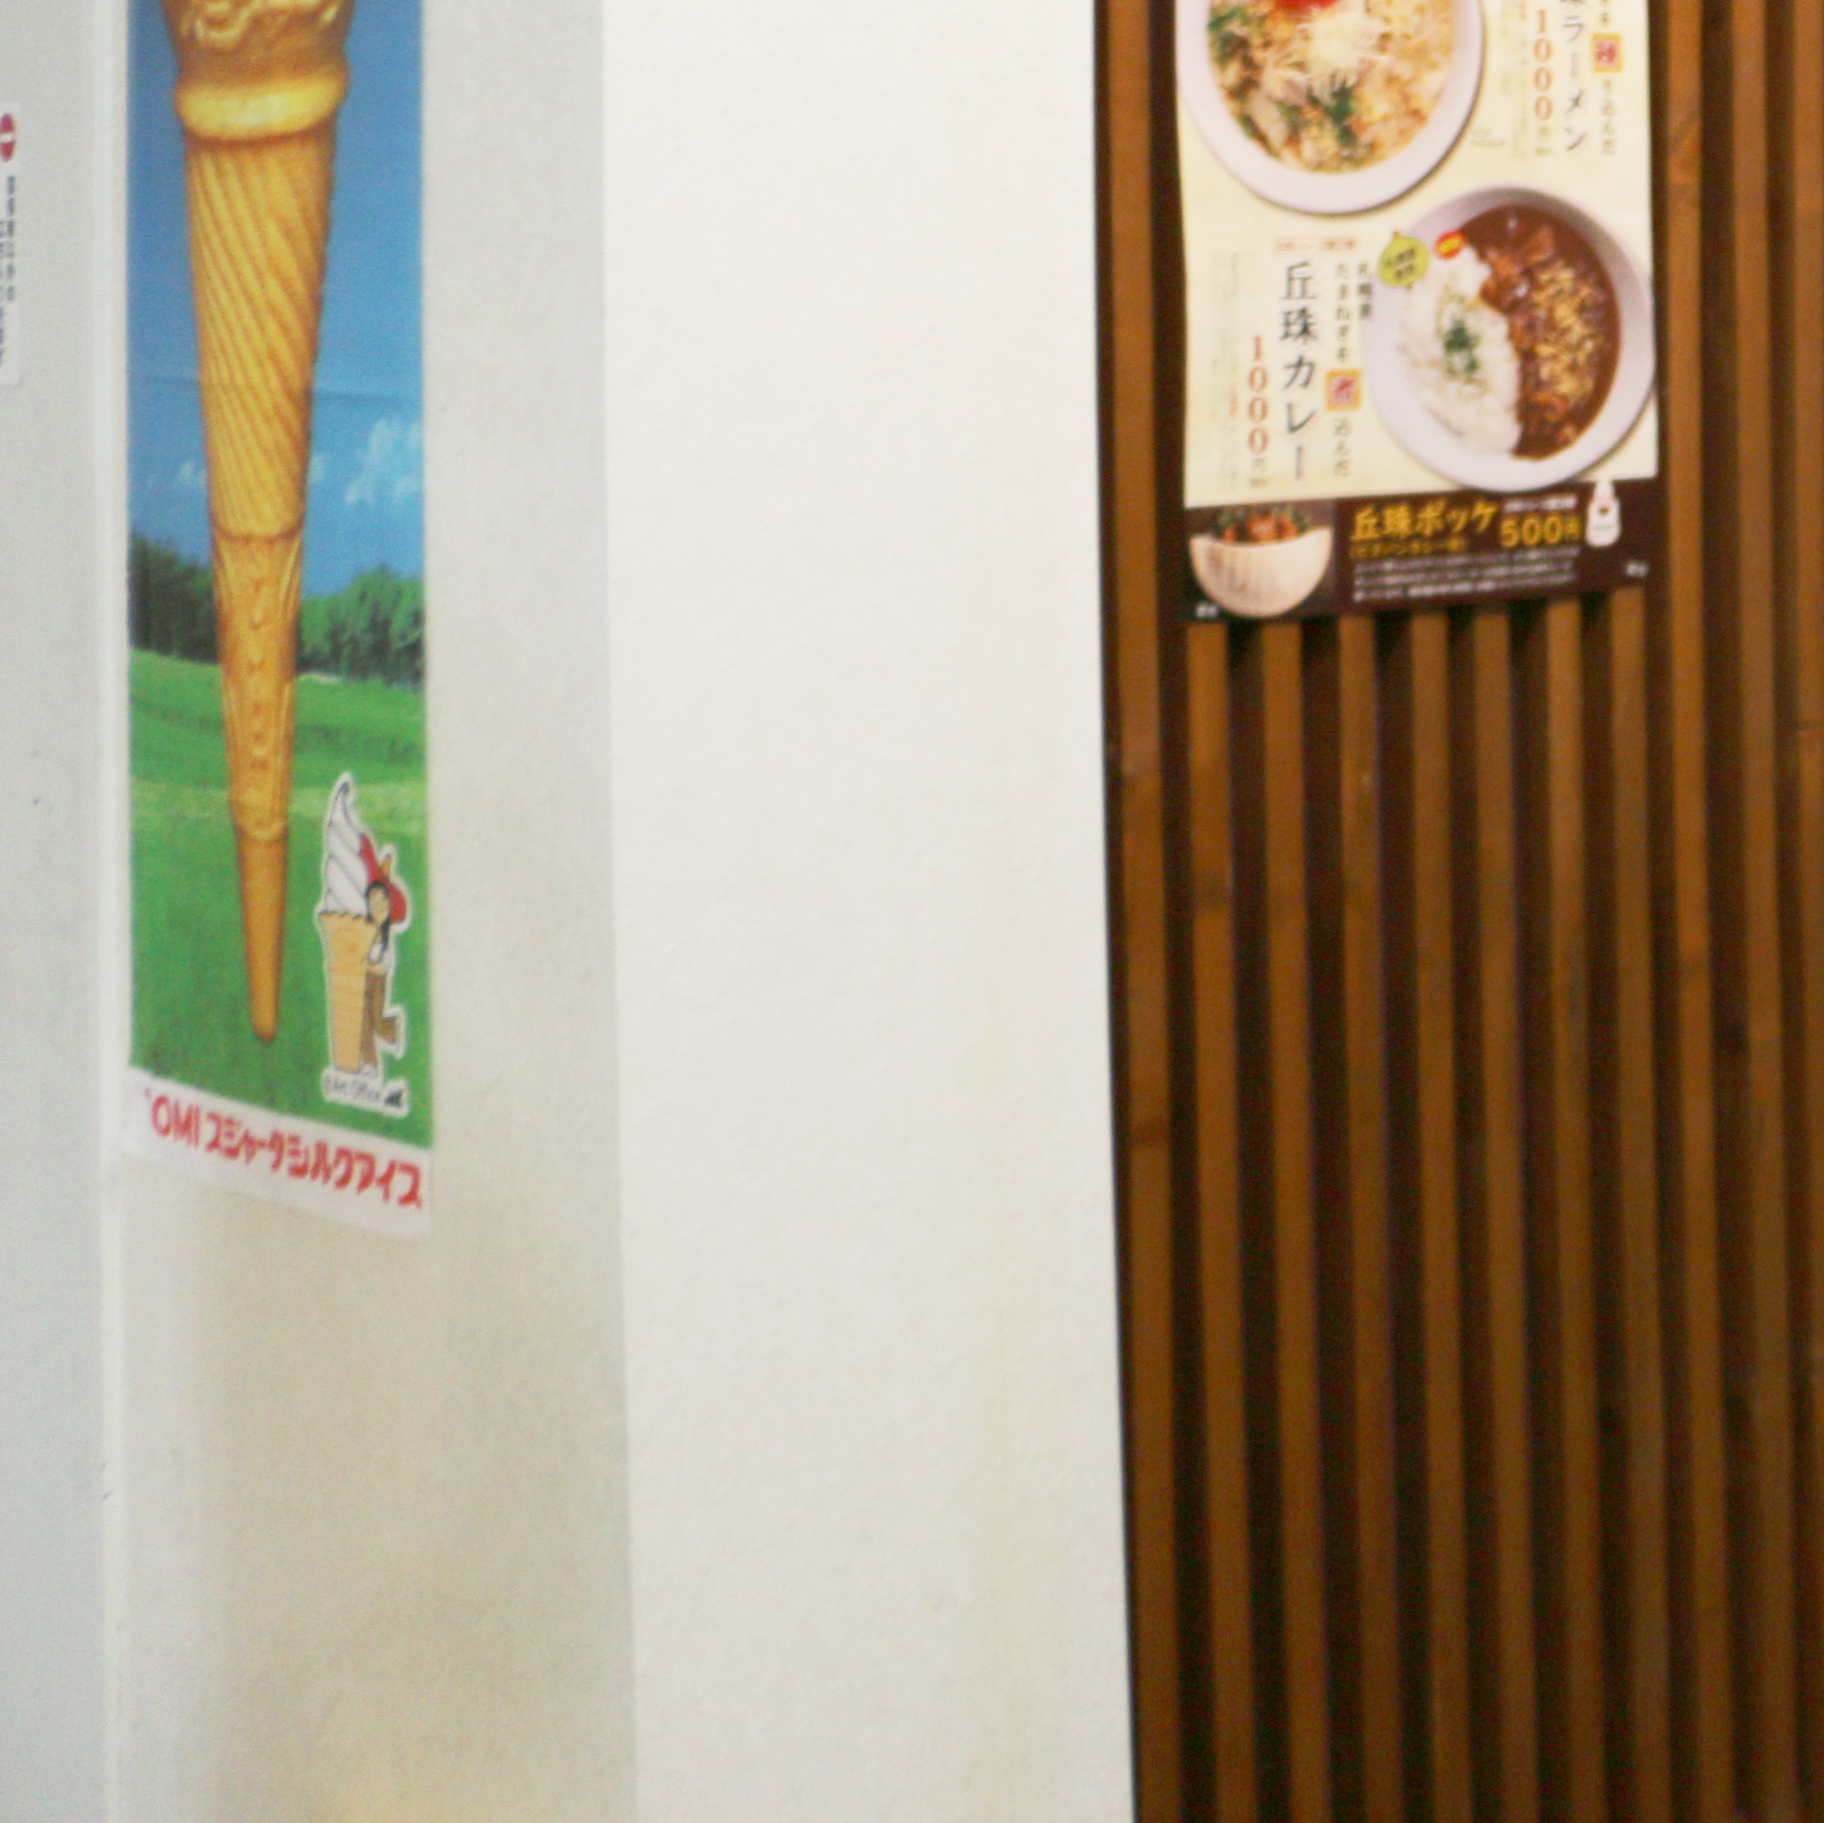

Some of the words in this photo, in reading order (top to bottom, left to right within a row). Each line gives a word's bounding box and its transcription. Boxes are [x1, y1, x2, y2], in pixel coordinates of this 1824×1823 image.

[1280, 260, 1319, 483] 丘珠カレー
[1350, 498, 1499, 541] 丘珠ポッケ
[1500, 514, 1581, 548] 500円
[204, 1110, 424, 1210] スジャータシルクアイス
